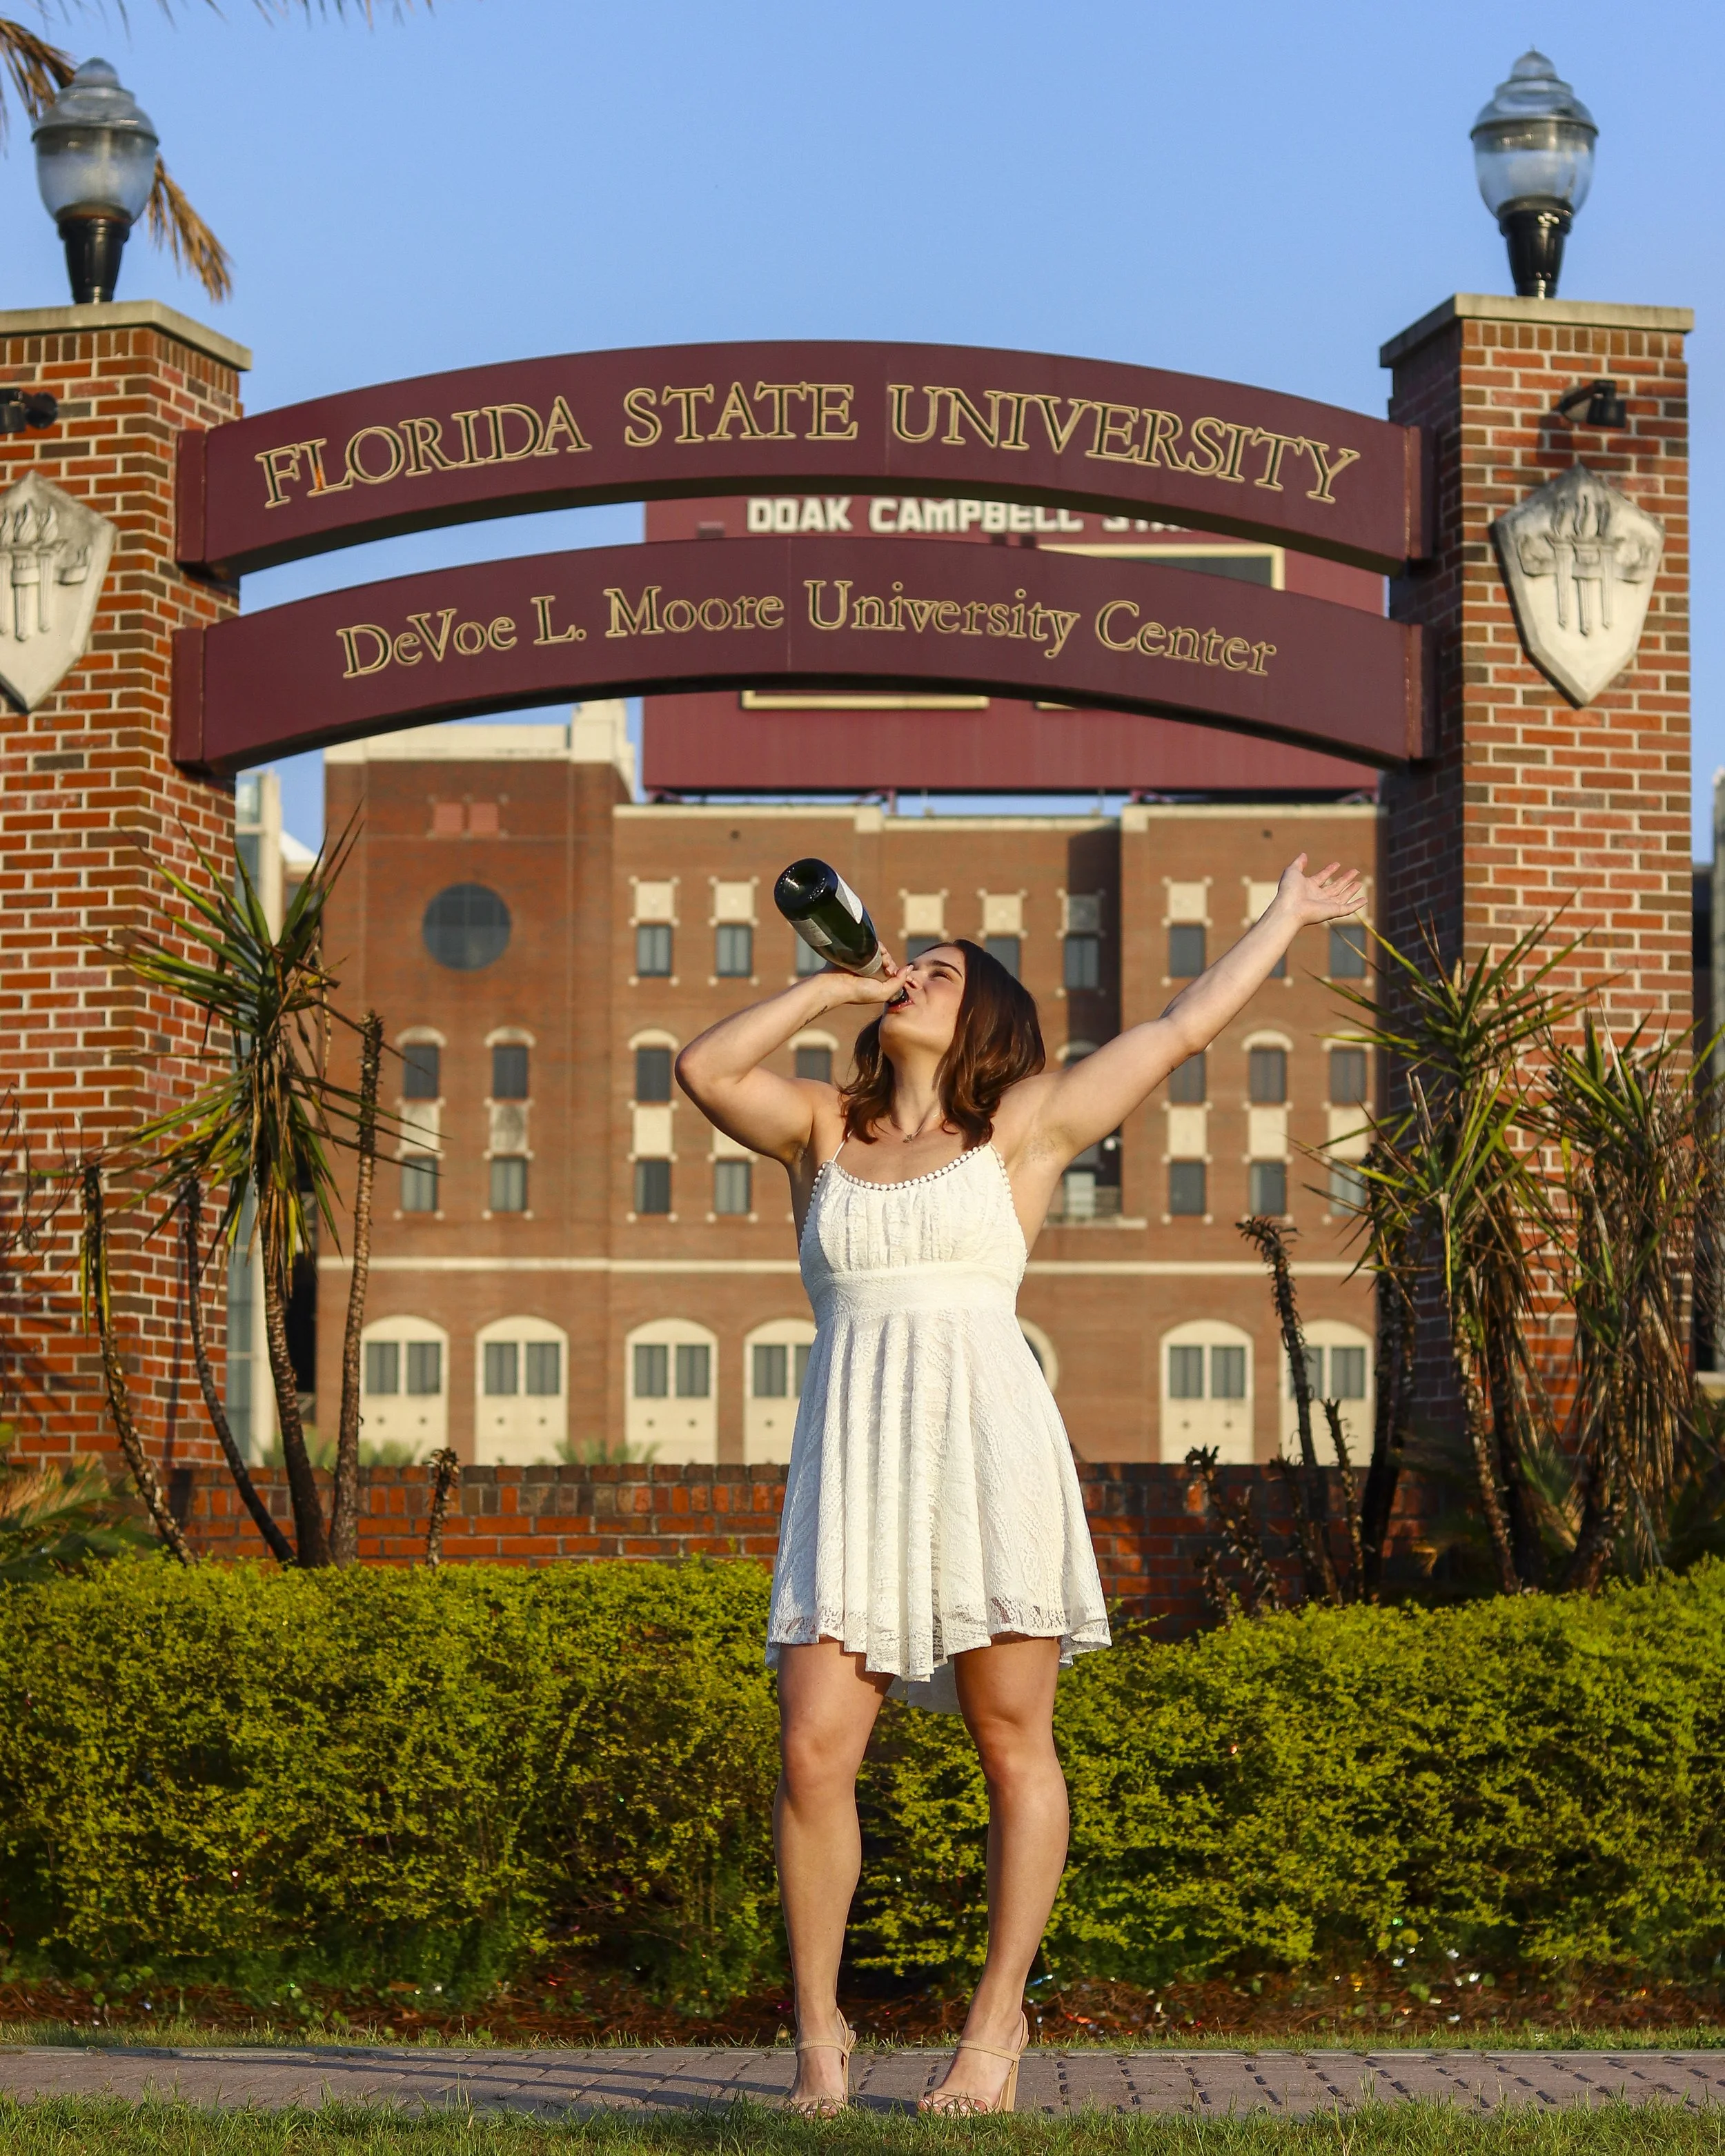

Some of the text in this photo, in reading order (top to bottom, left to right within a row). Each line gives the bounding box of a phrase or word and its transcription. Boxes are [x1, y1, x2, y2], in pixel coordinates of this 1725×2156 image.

[255, 382, 1359, 508] FLORIDA STATE UNIVERSITY
[747, 496, 854, 533] DOAK
[868, 496, 1085, 533] CAMPBELL
[336, 580, 1277, 679] DeVoe L. Moore University Center
